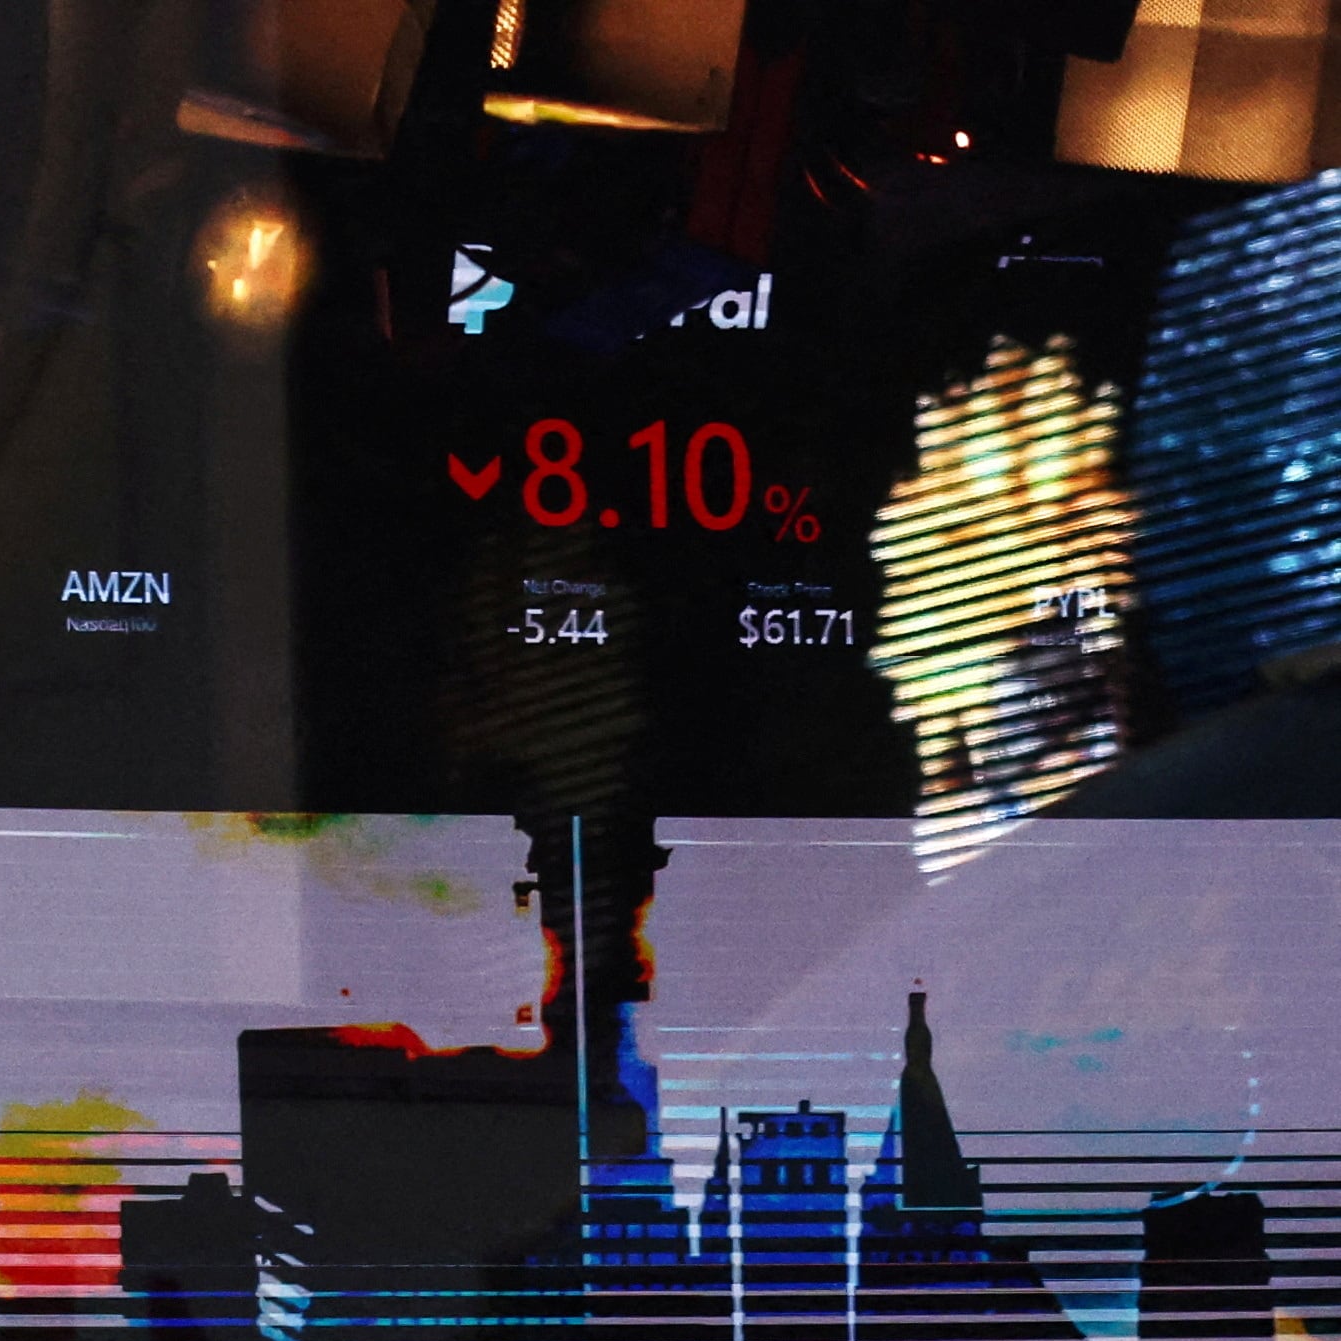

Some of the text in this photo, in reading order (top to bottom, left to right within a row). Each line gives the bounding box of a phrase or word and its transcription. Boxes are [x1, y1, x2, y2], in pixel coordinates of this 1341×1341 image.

[60, 569, 171, 605] AMZN
[506, 607, 610, 646] -5.44
[737, 603, 855, 650] $61.71
